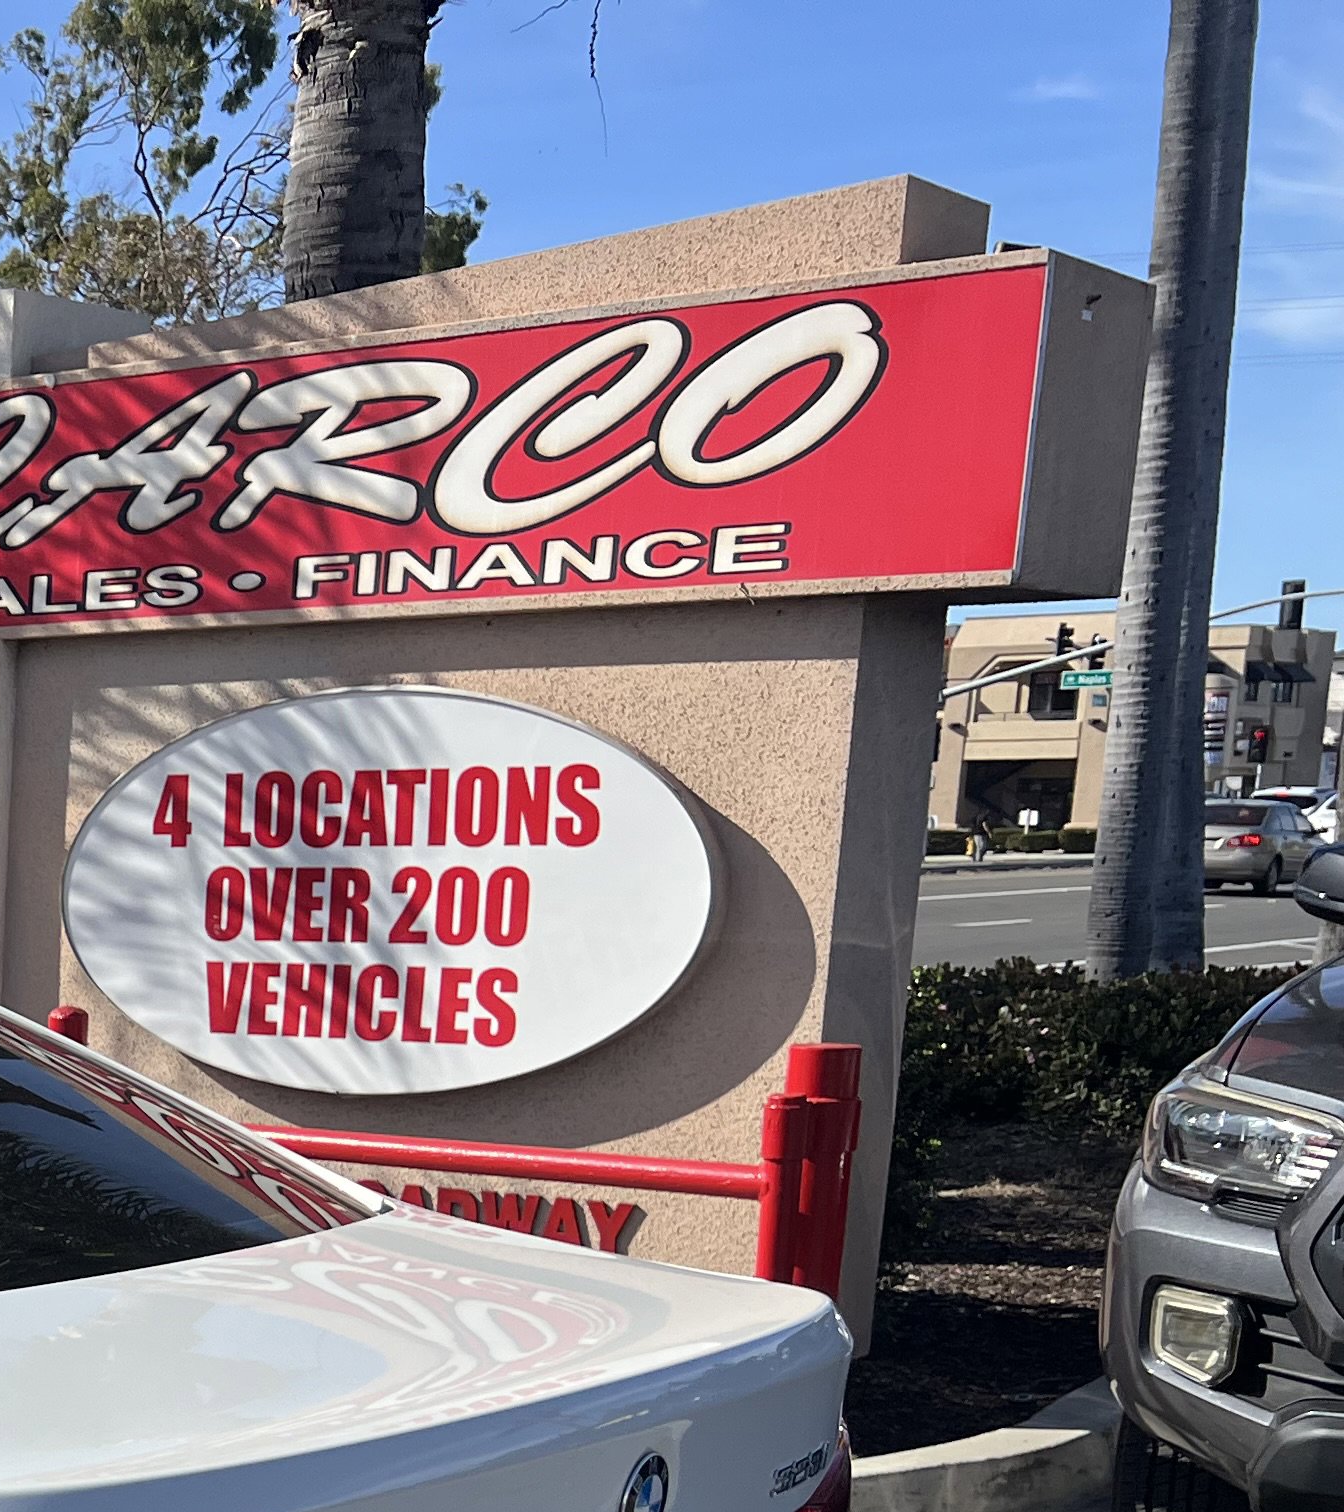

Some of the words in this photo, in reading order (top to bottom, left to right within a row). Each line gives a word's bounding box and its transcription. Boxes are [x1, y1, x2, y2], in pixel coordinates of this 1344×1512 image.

[292, 520, 792, 601] FINANCE
[152, 774, 193, 848] 4
[221, 762, 602, 849] LOCATIONS
[204, 866, 372, 944] OVER
[387, 866, 532, 948] 200
[205, 958, 520, 1048] VEHICLES
